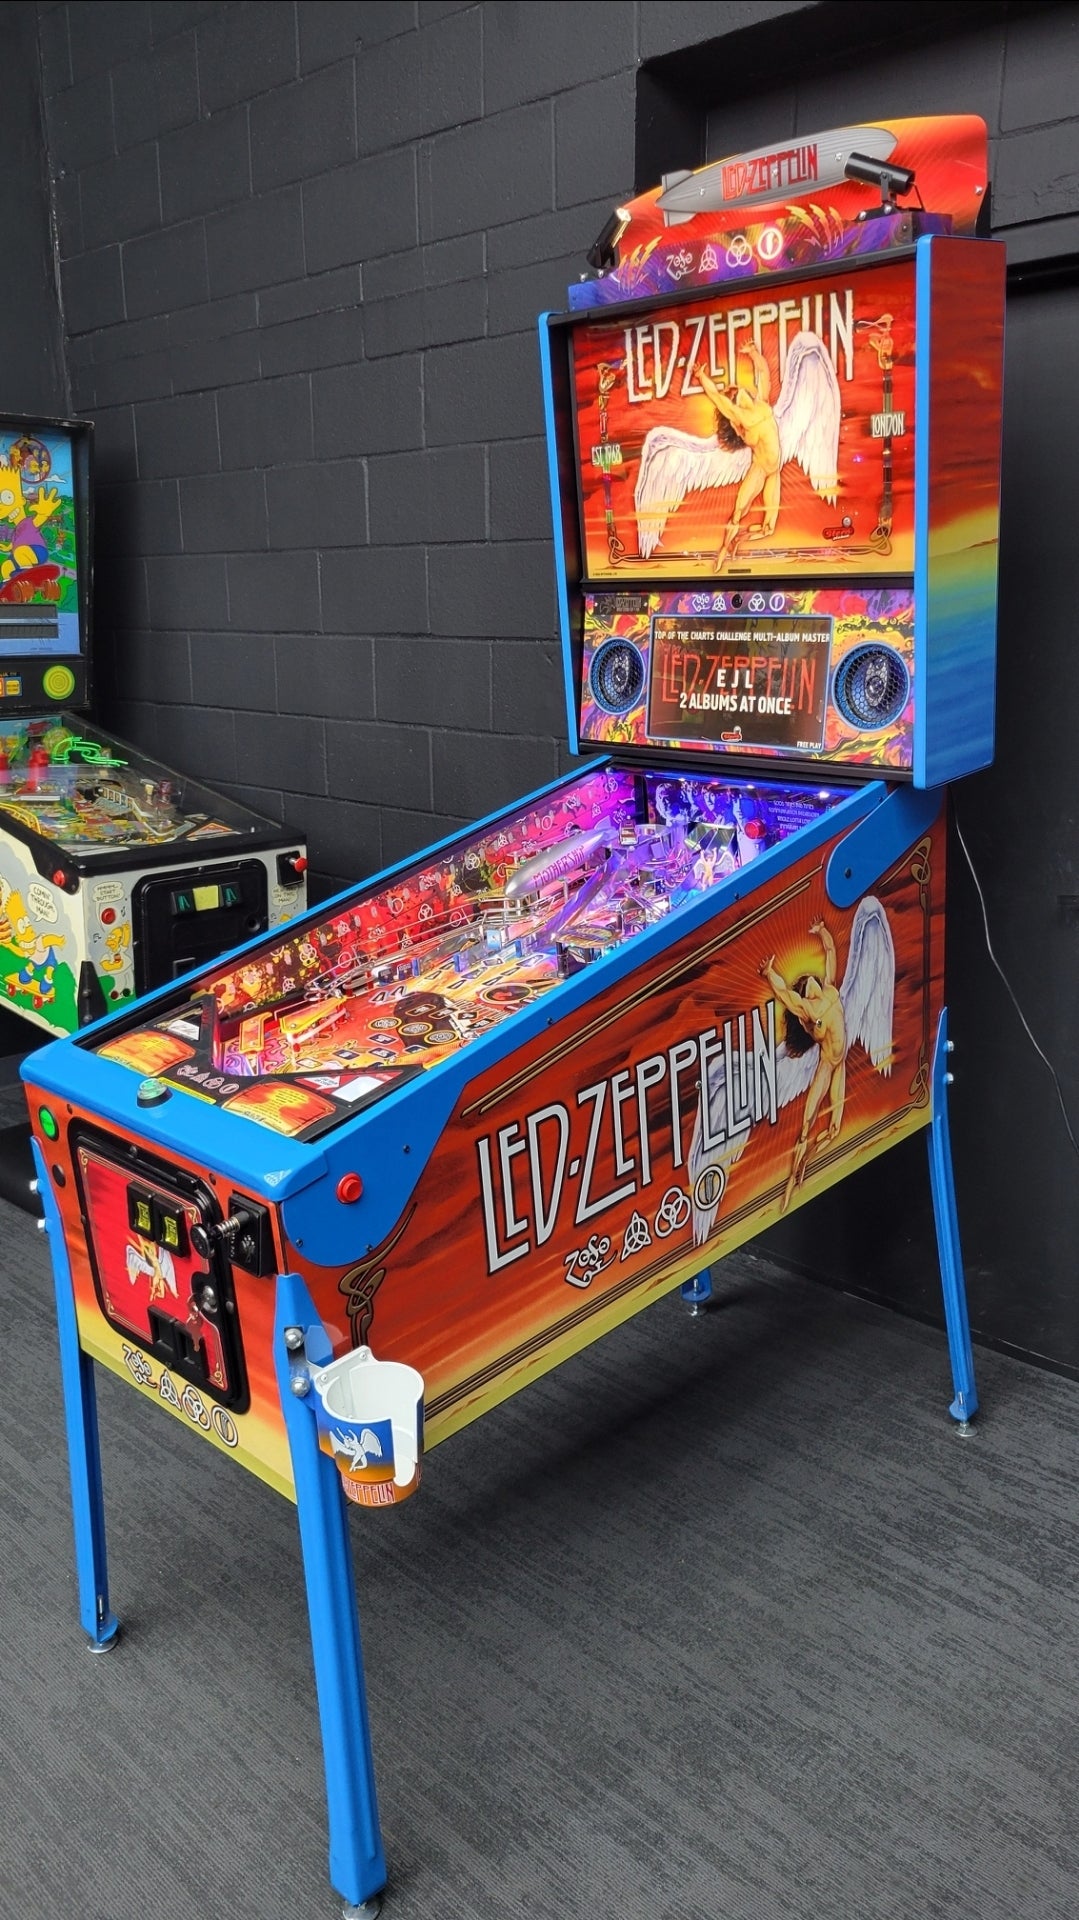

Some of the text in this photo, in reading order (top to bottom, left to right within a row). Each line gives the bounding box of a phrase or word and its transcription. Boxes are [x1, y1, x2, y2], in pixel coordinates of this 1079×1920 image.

[872, 412, 905, 438] LONDON
[655, 631, 830, 643] TOP OF THE CHARTS CHALLENGE MULTI-ALBUM MASTER
[679, 694, 792, 715] 2 ALBUMS AT ONCE
[532, 845, 585, 888] MOTHERSHIP
